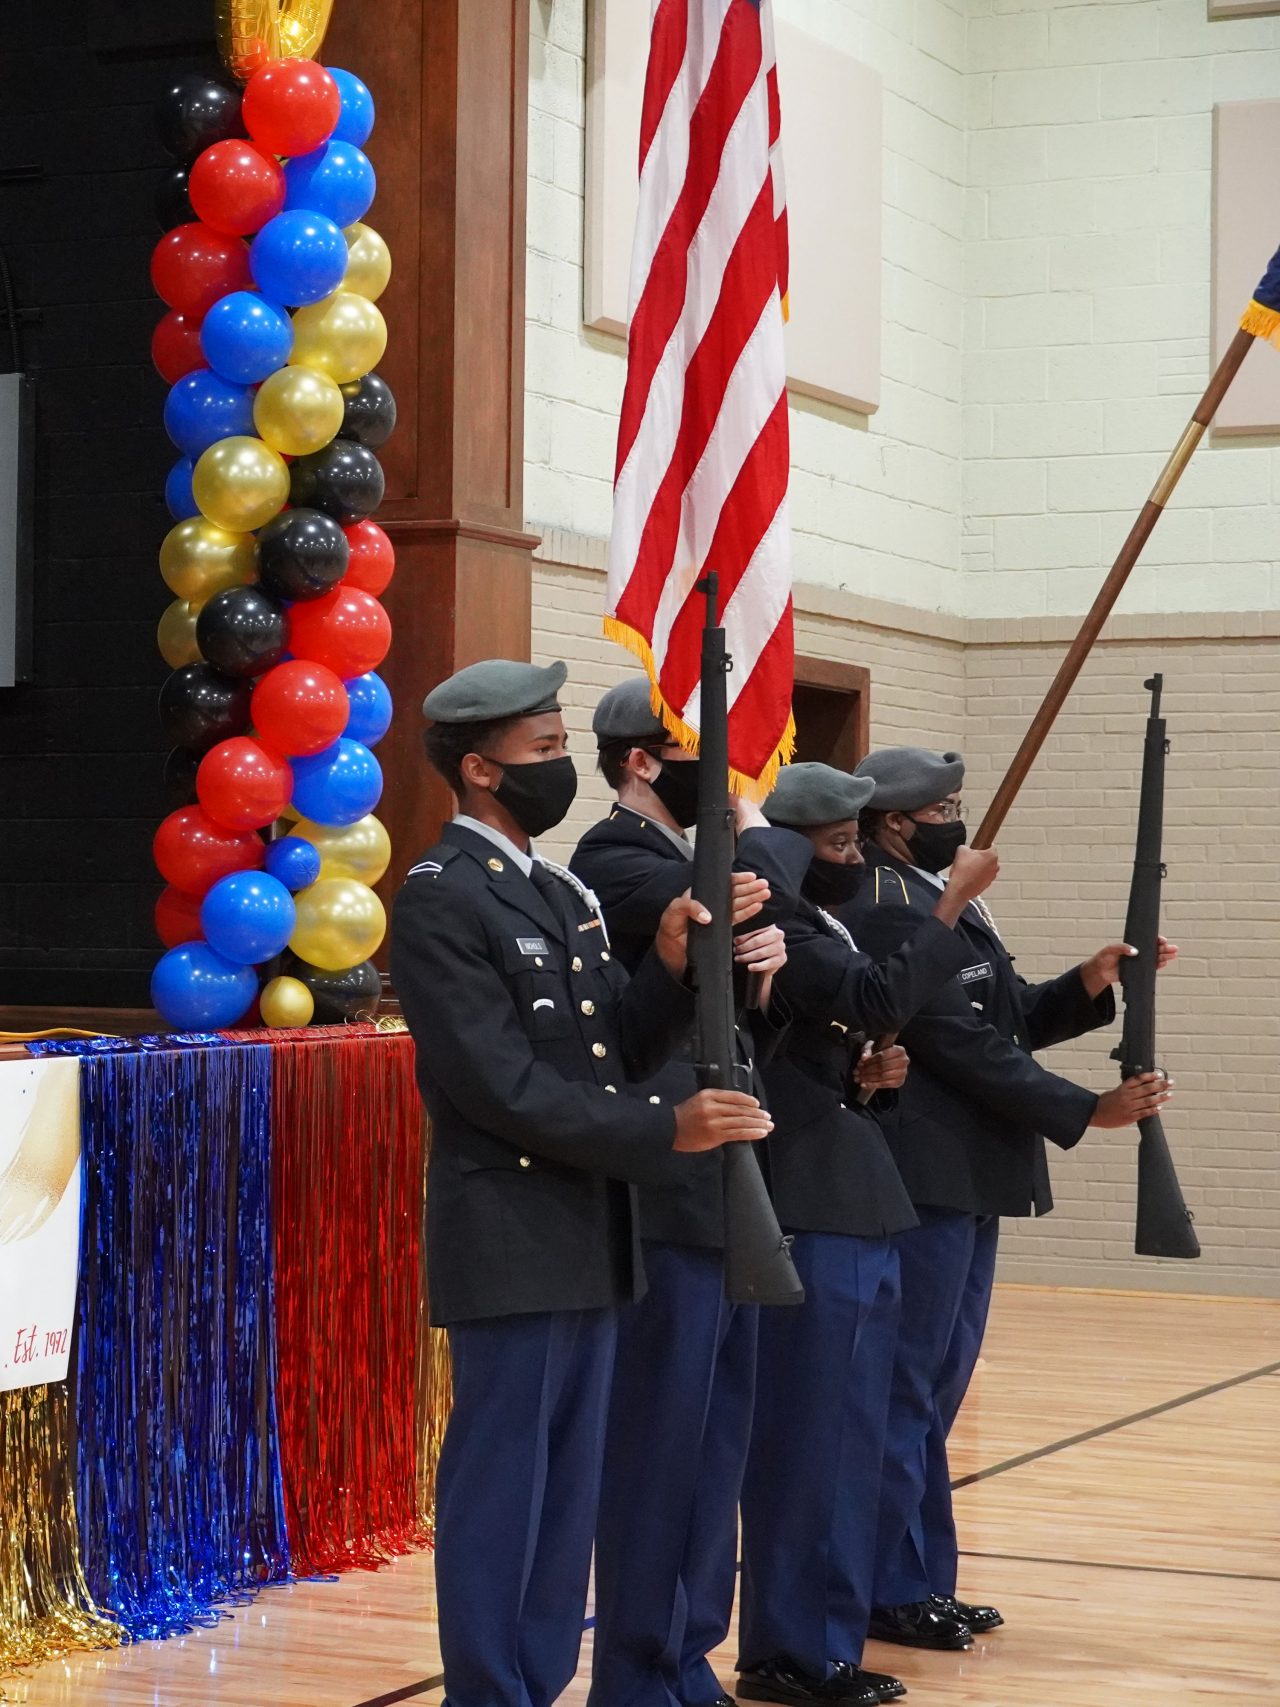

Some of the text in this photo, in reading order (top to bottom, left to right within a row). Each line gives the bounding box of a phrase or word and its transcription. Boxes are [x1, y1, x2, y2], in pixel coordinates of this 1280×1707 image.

[961, 967, 987, 980] COPELAND
[13, 1324, 68, 1364] Est. 1972
